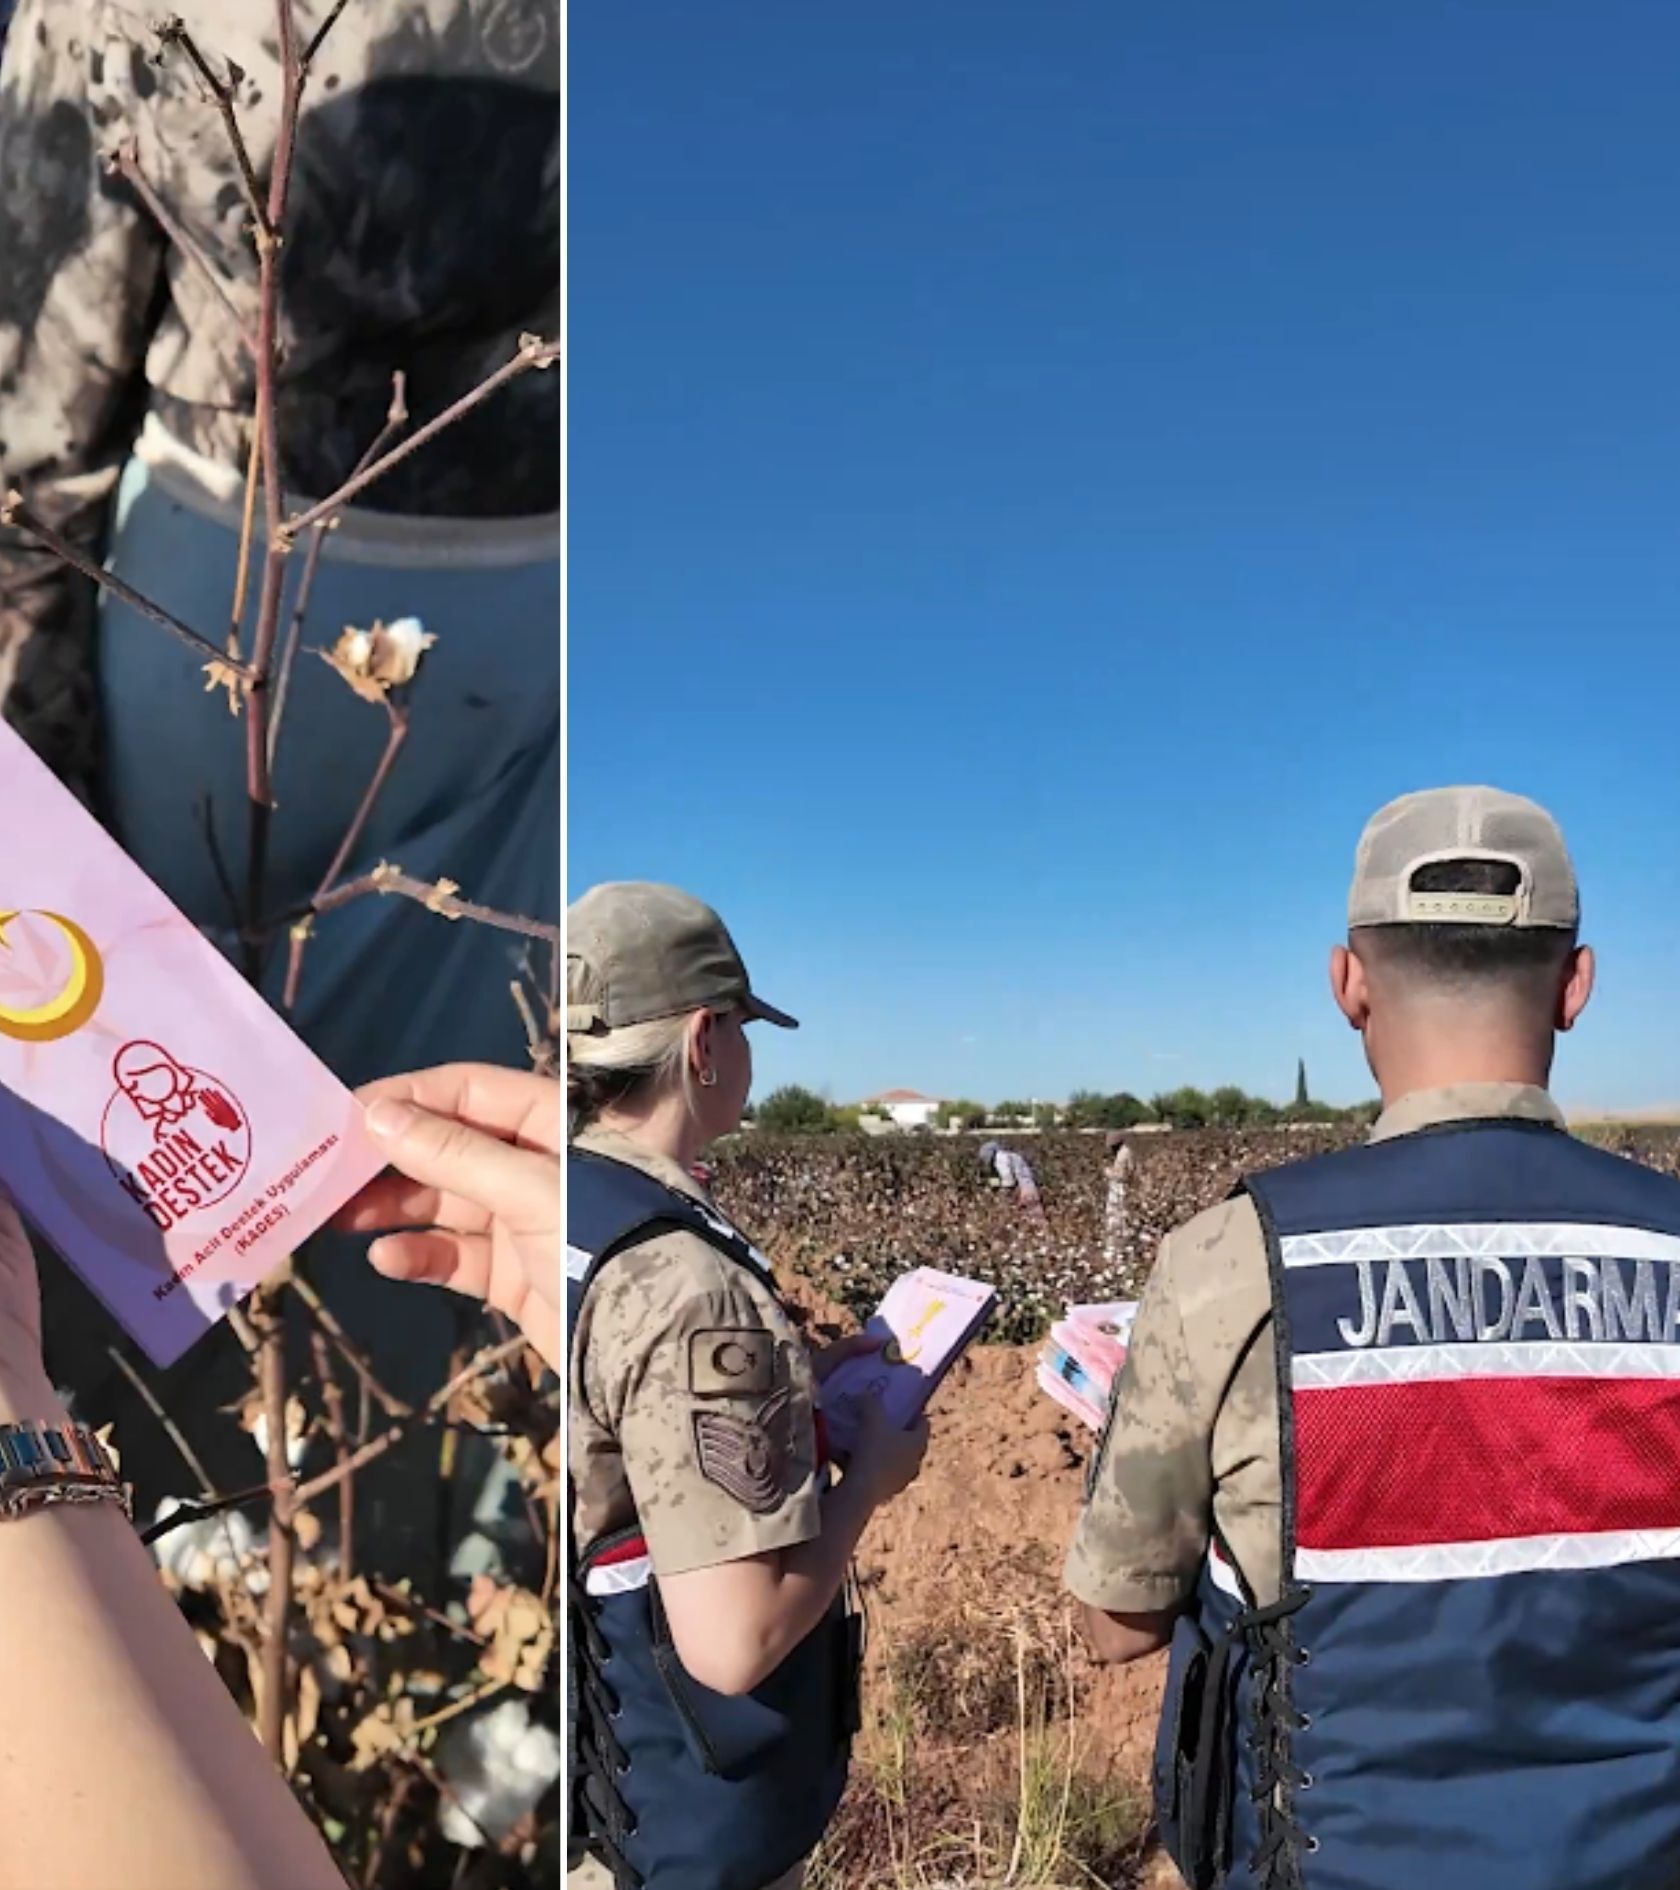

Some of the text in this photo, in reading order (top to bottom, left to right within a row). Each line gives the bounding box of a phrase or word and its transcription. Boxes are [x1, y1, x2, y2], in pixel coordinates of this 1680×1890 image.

[119, 1128, 204, 1205] KADIN
[142, 1140, 244, 1233] DESTEK
[152, 1133, 340, 1301] Kadın Acil Destek Uygulaması
[234, 1202, 292, 1257] (KADES)
